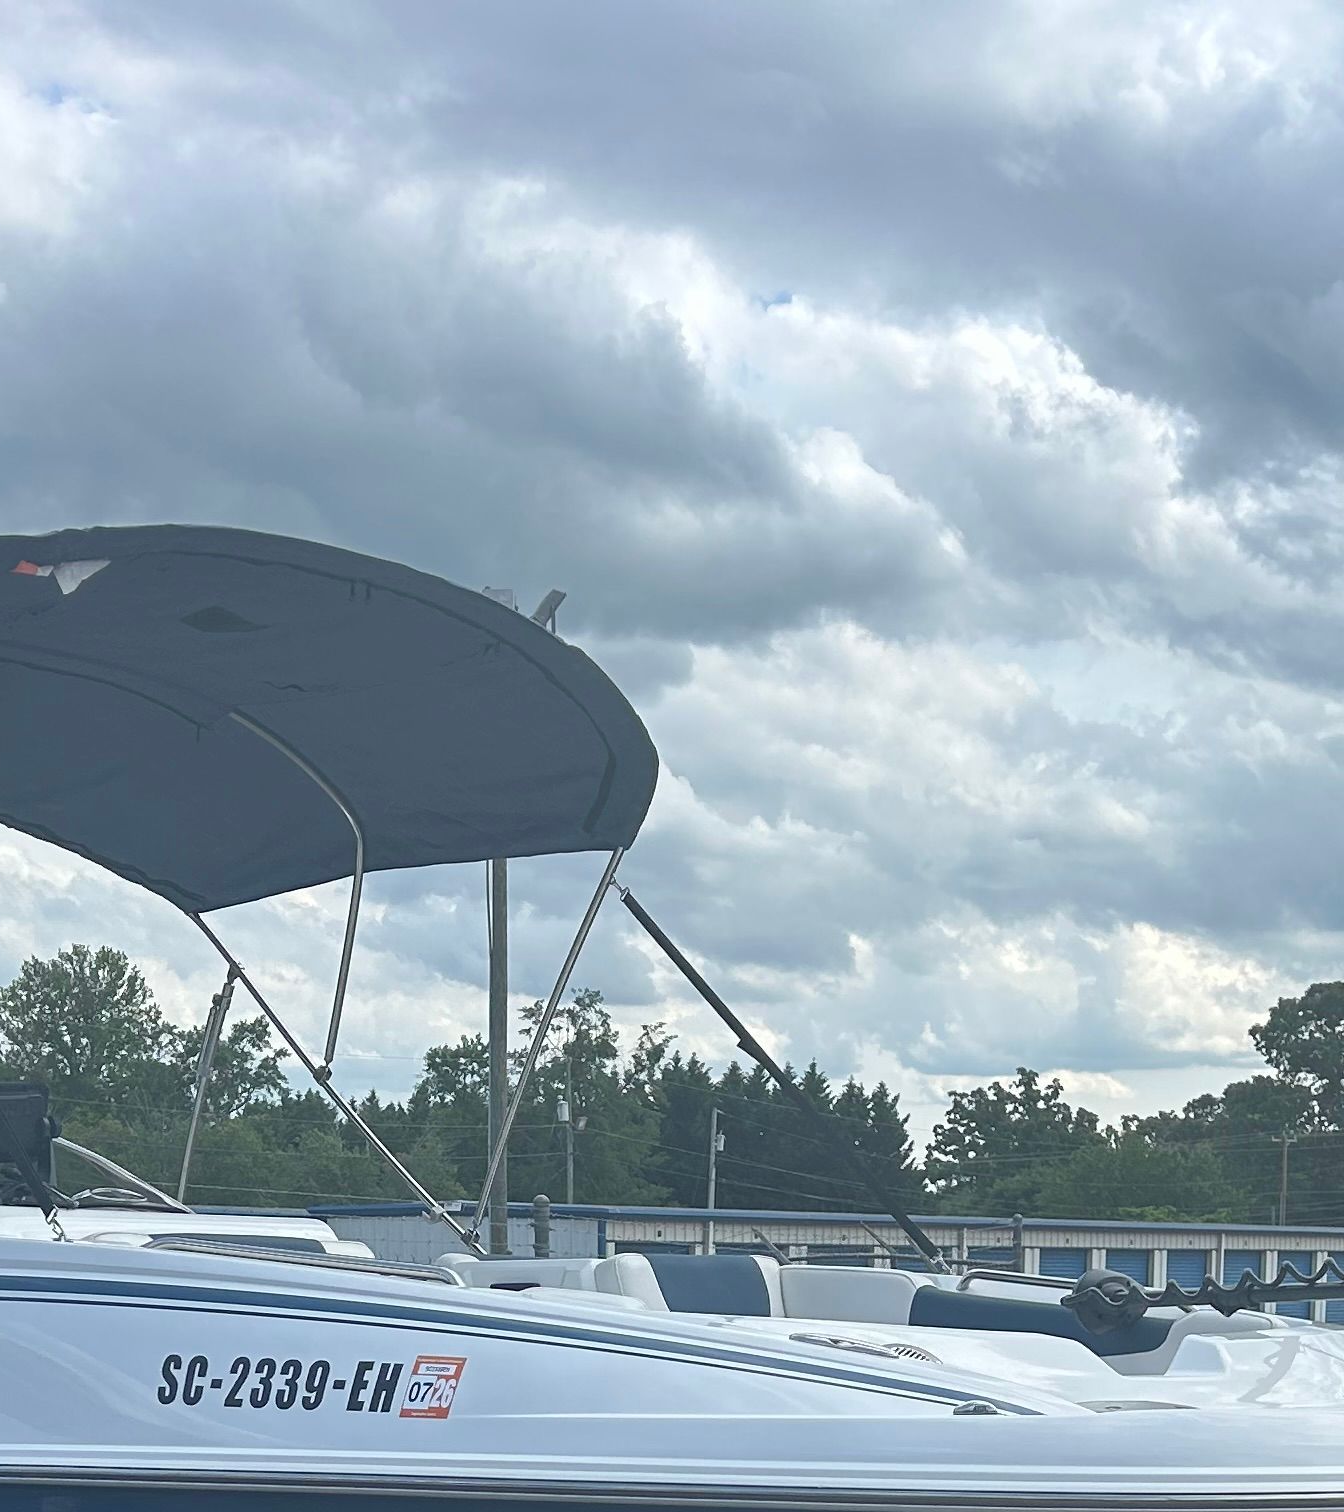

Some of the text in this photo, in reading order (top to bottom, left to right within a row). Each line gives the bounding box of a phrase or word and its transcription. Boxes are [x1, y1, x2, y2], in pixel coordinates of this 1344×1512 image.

[157, 1354, 405, 1413] SC-2339-EH
[408, 1378, 457, 1408] 07 26
